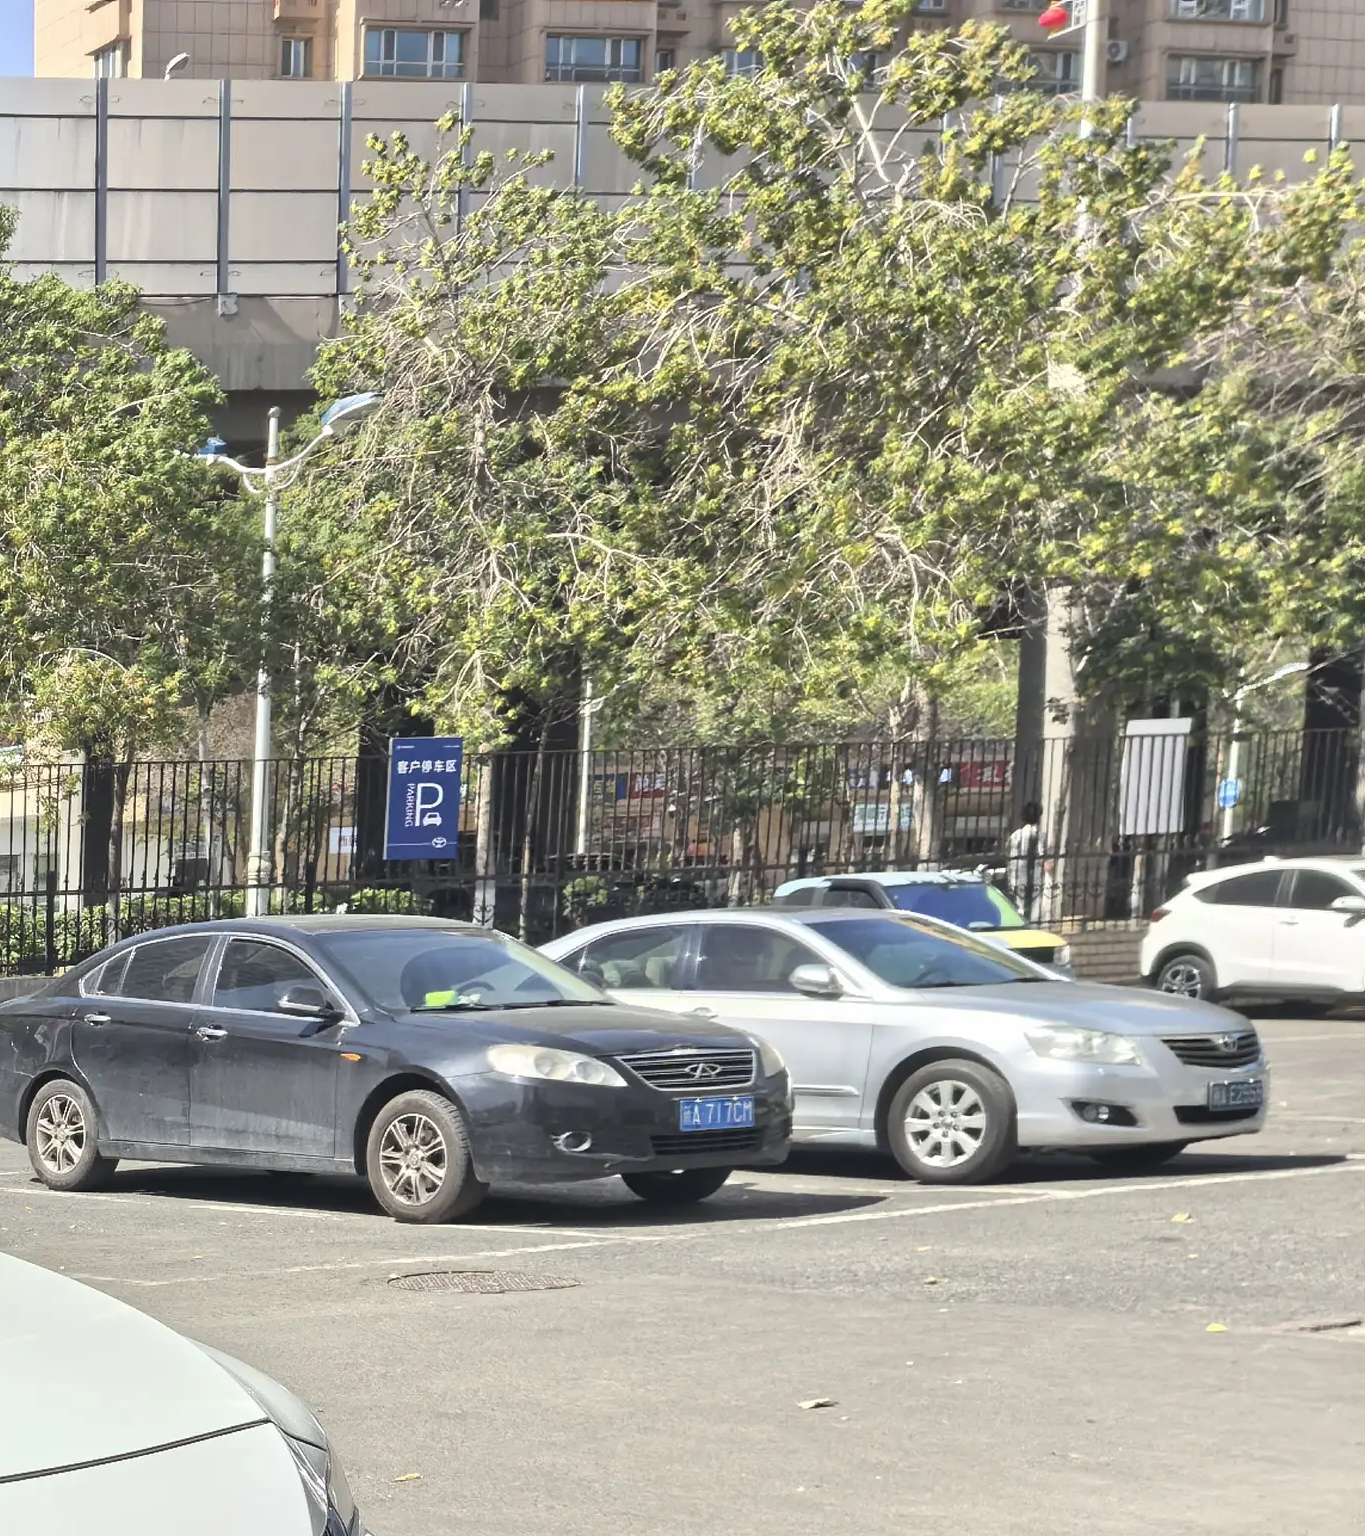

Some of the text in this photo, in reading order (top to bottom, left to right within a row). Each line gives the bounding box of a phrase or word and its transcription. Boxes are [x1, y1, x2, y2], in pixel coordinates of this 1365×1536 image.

[396, 759, 458, 774] 客户停车区
[404, 783, 416, 827] PARKING
